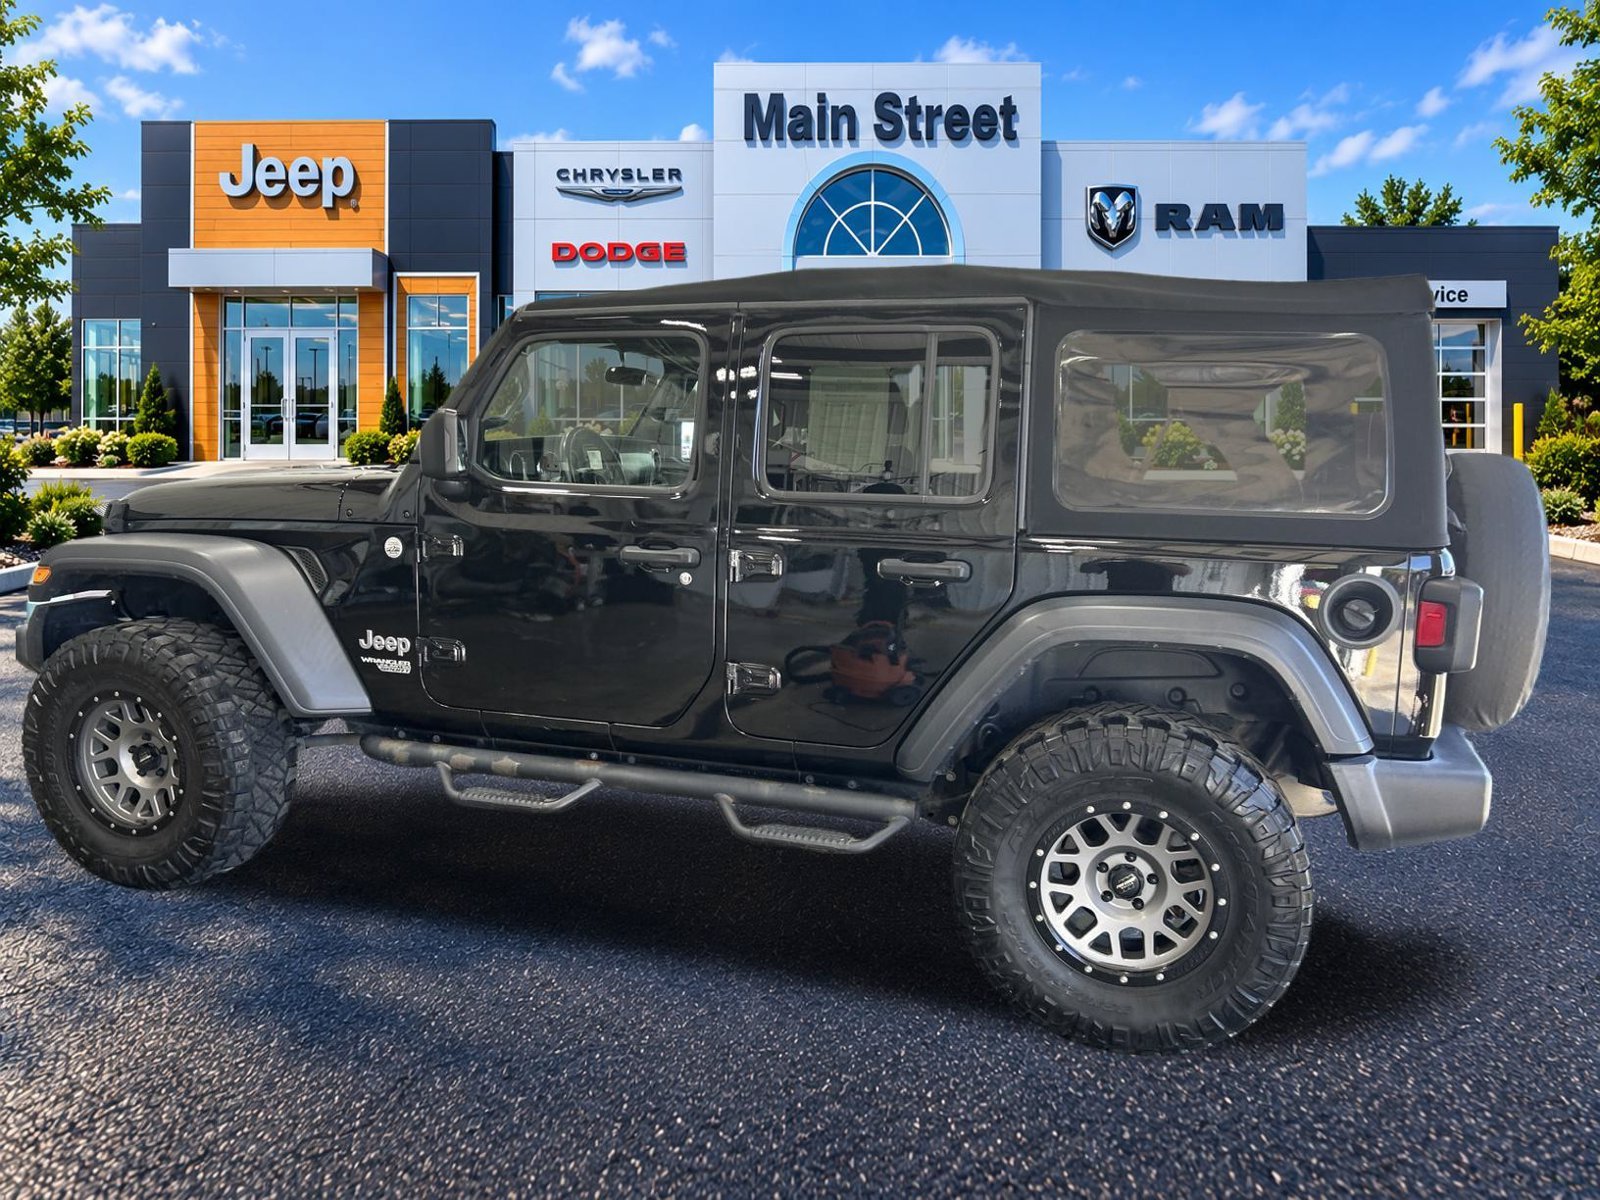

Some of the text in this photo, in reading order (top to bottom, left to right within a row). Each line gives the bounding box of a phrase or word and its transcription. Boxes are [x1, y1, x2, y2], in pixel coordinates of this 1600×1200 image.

[743, 92, 1018, 141] Main Street
[218, 143, 355, 208] Jeep
[556, 168, 682, 181] CHRYSLER
[1155, 203, 1284, 231] RAM
[552, 242, 686, 262] DODGE
[358, 629, 411, 657] Jeep
